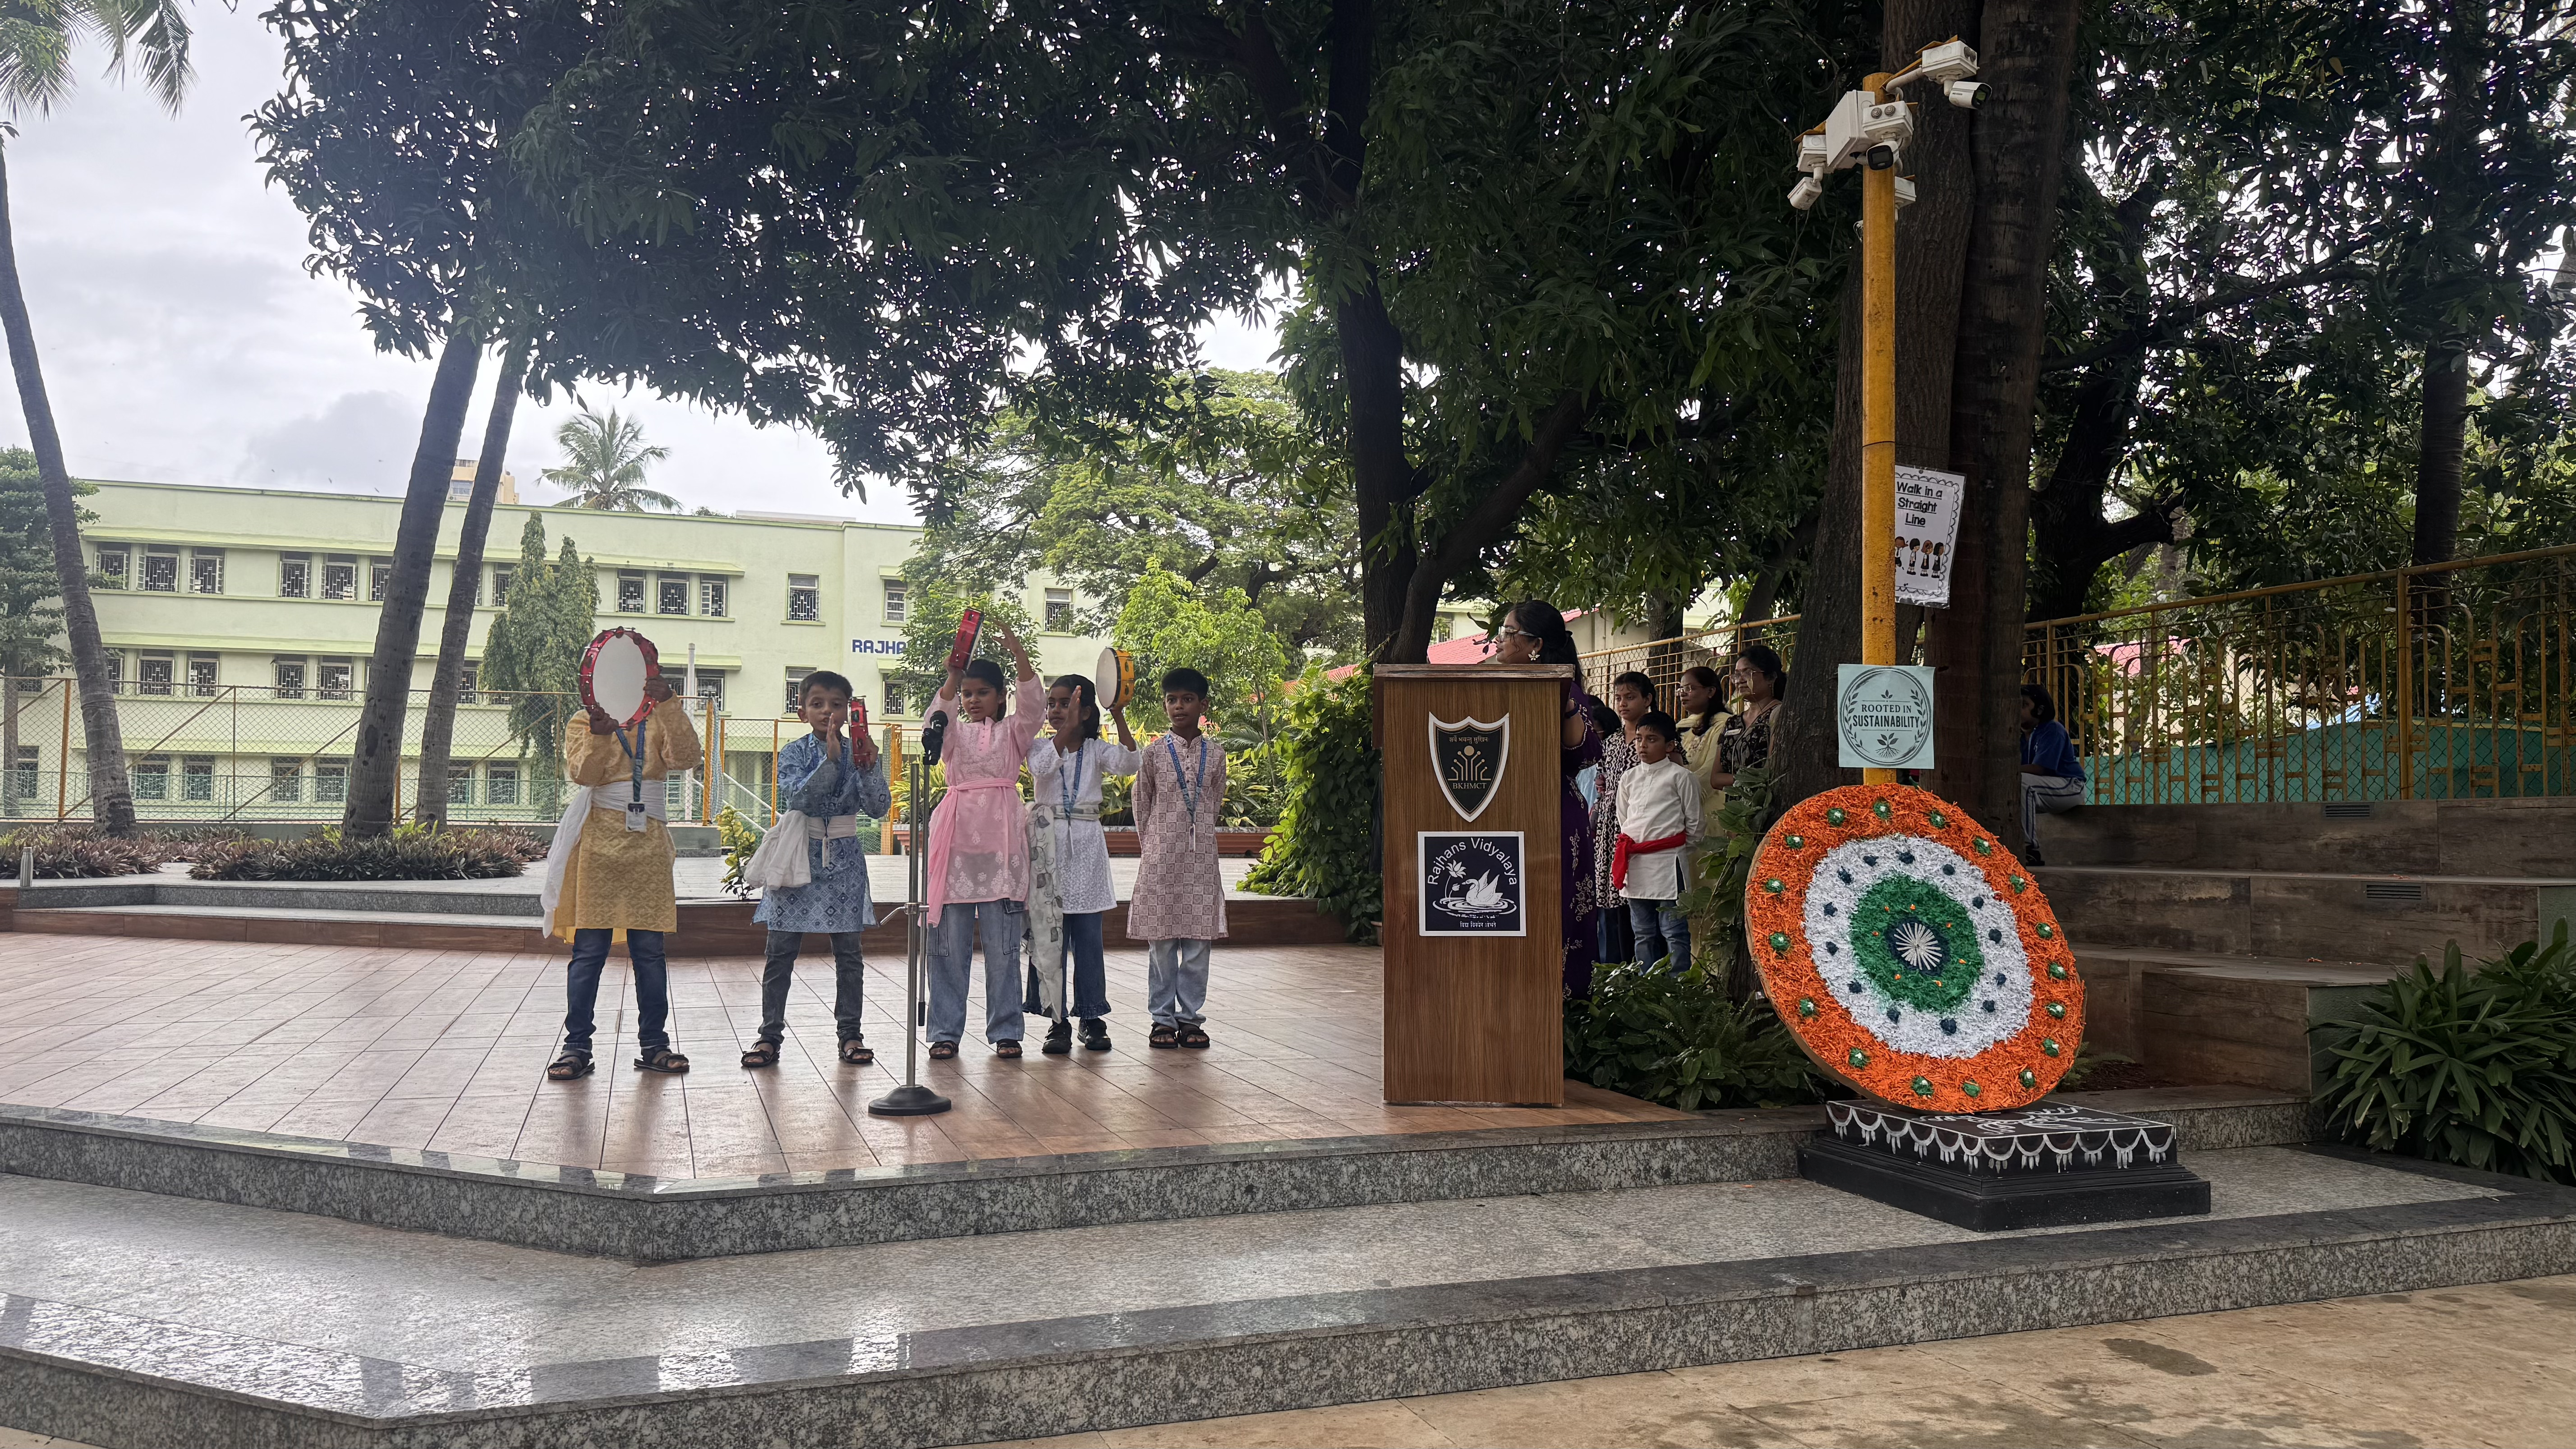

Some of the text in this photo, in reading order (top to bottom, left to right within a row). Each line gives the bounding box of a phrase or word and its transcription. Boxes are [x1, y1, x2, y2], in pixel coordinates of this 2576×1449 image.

[1897, 481, 1922, 494] Walk
[1925, 486, 1933, 497] in
[1898, 497, 1937, 513] Straight
[1905, 513, 1926, 525] Line
[1862, 704, 1900, 713] ROOTED
[1853, 715, 1920, 728] SUSTAINABILITY
[1427, 837, 1517, 885] Rajhans Vidyalaya
